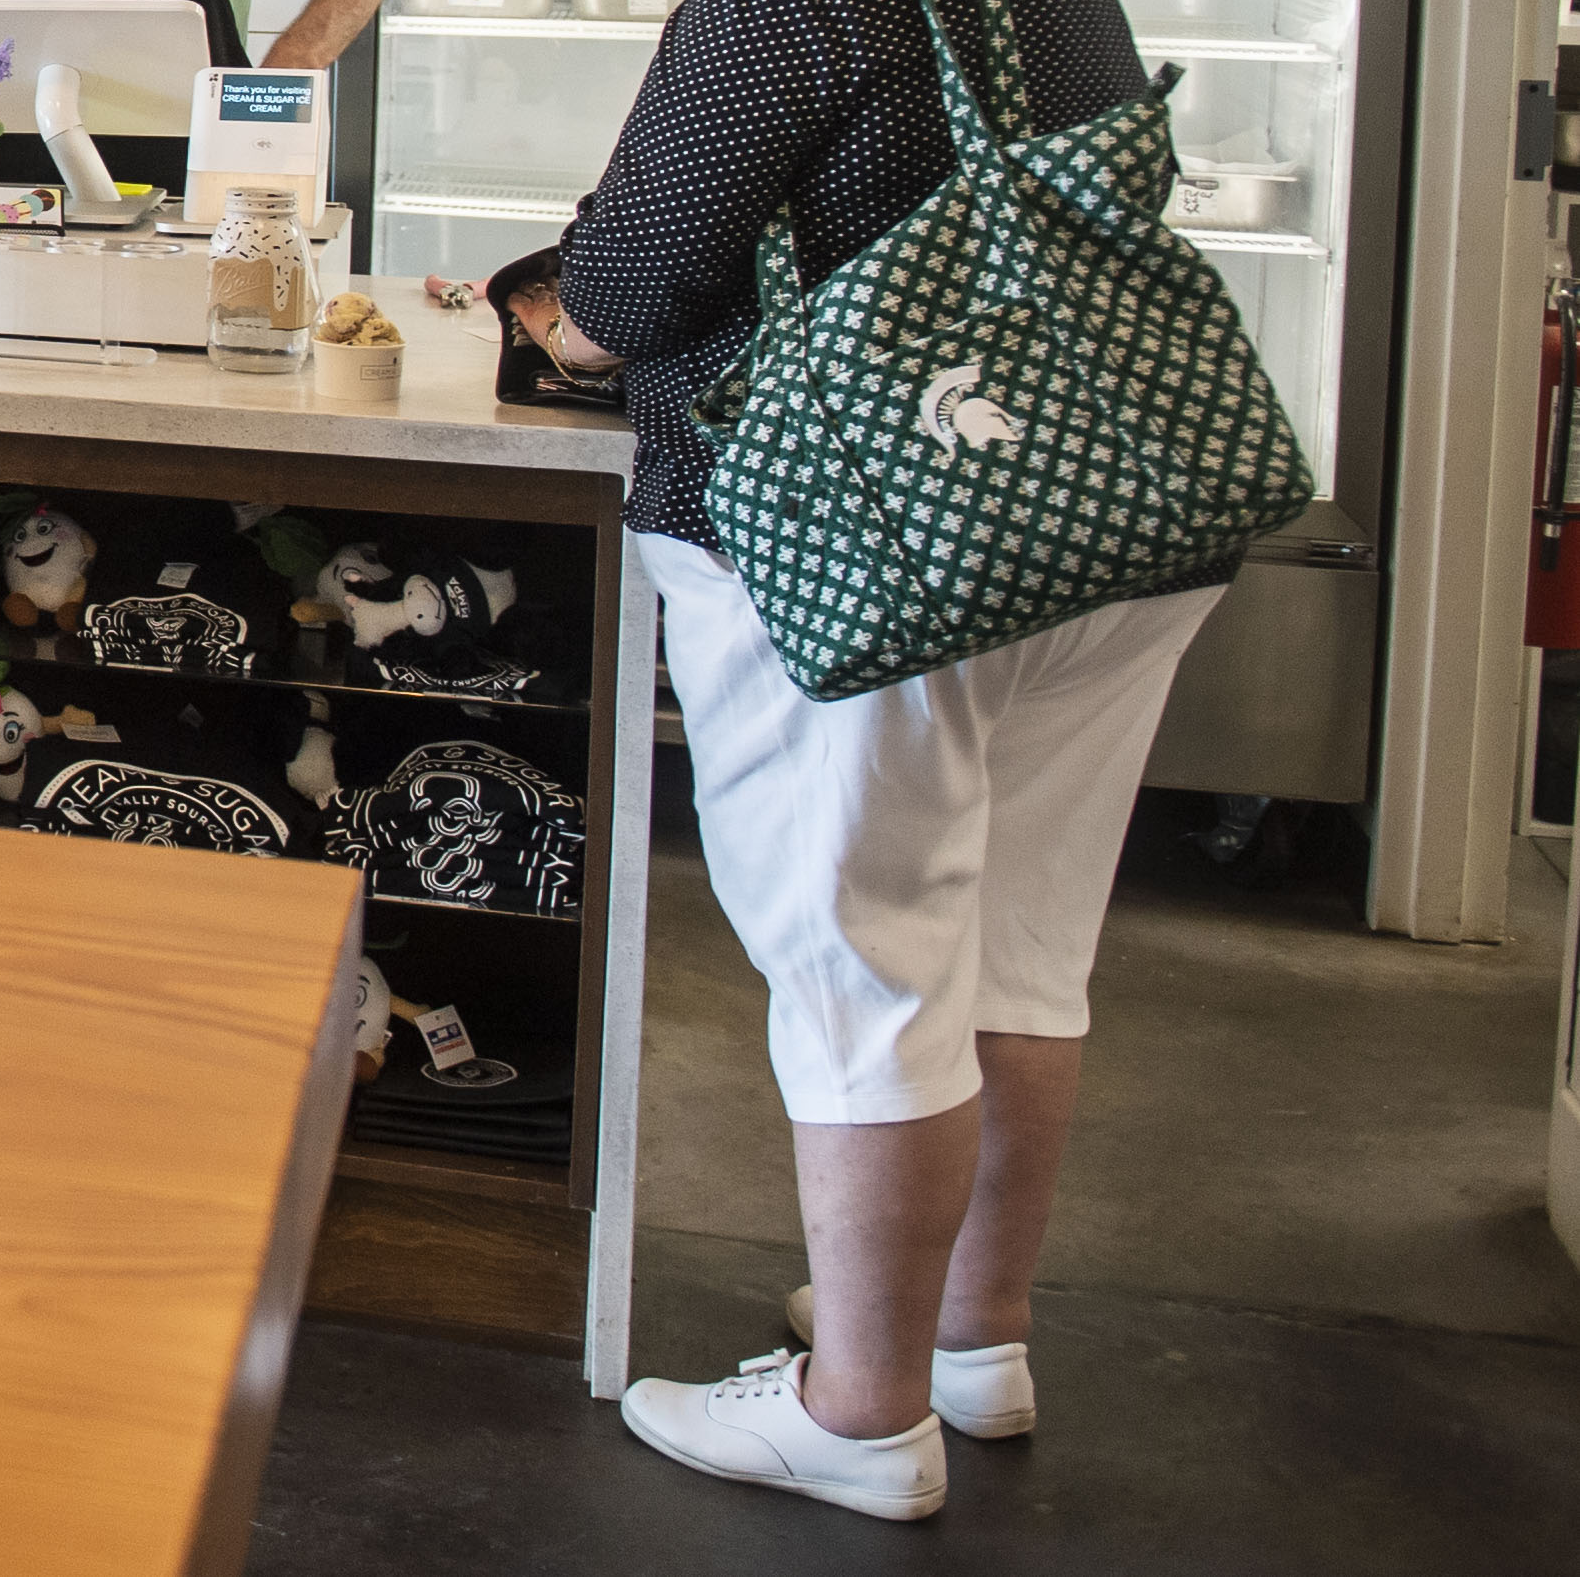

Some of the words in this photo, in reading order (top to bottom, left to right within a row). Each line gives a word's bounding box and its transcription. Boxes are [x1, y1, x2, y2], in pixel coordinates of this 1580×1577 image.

[224, 85, 249, 93] Thank
[250, 86, 266, 95] you
[268, 86, 279, 94] for
[280, 87, 311, 95] visiting
[222, 95, 254, 103] CREAM
[264, 96, 294, 104] SUGAR
[296, 96, 311, 104] ICE
[249, 104, 282, 113] CREAM
